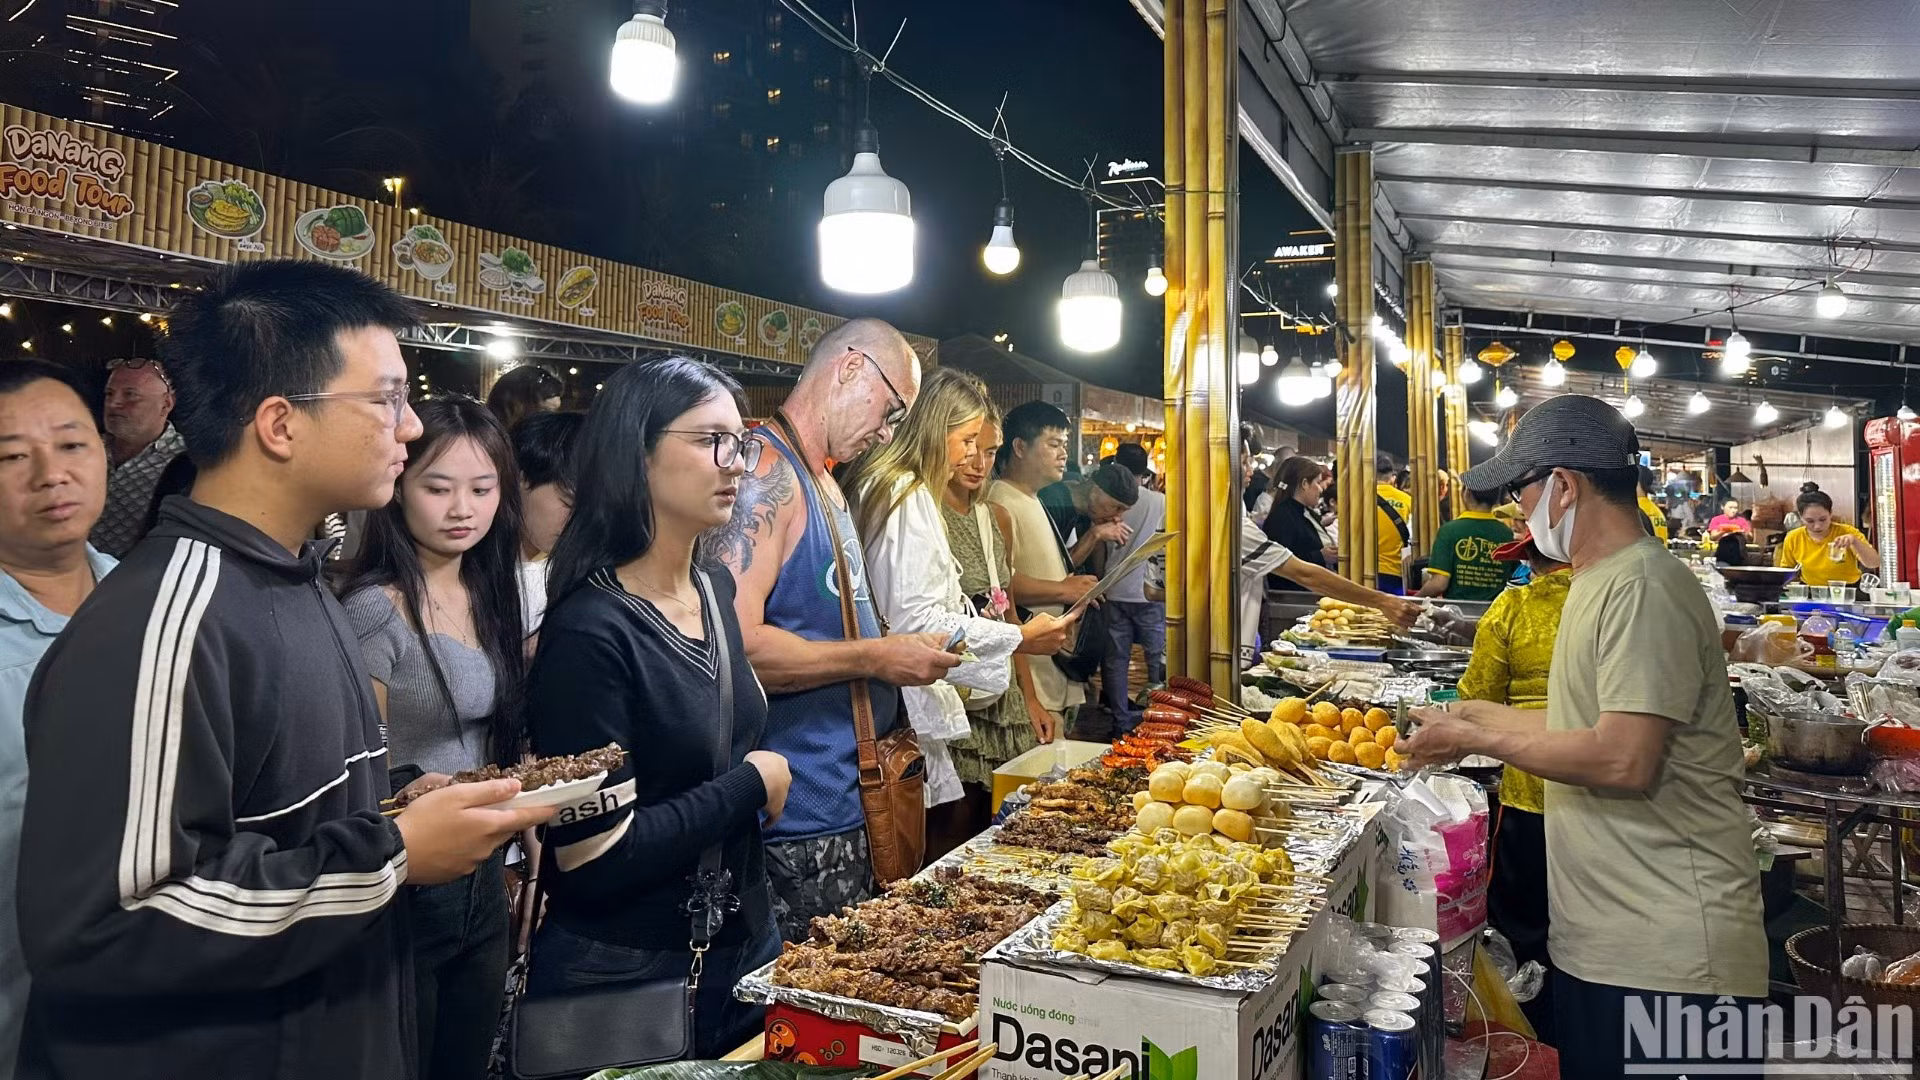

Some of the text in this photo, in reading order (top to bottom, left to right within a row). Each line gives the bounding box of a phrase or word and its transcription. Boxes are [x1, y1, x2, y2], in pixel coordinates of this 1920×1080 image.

[72, 172, 134, 218] Tour
[559, 792, 619, 824] ash
[1048, 1009, 1075, 1025] đóng
